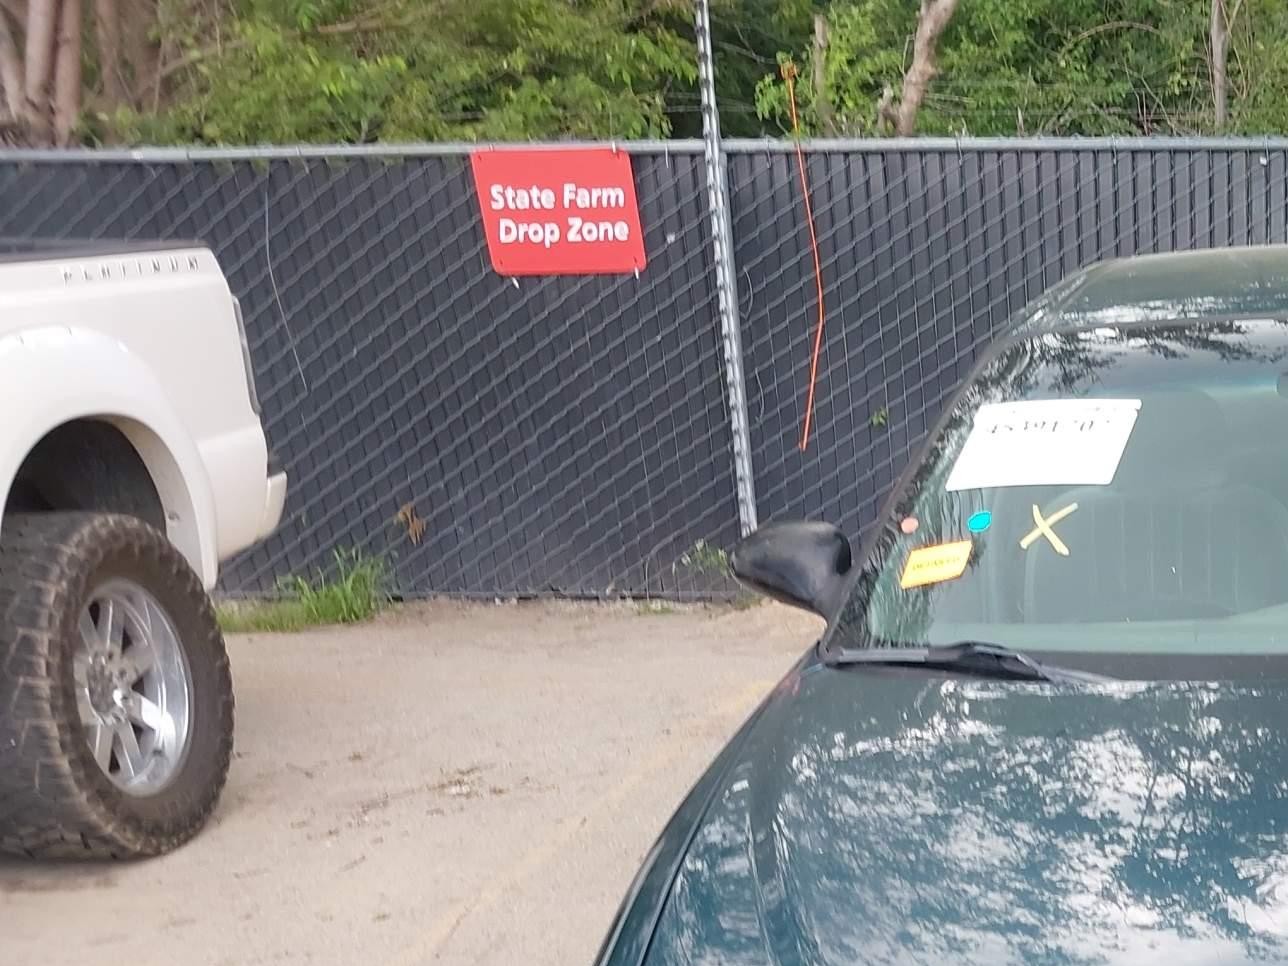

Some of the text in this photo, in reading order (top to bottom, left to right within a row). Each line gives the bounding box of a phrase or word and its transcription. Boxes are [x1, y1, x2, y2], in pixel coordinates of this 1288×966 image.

[490, 183, 625, 210] State Farm
[499, 217, 629, 248] Drop Zone
